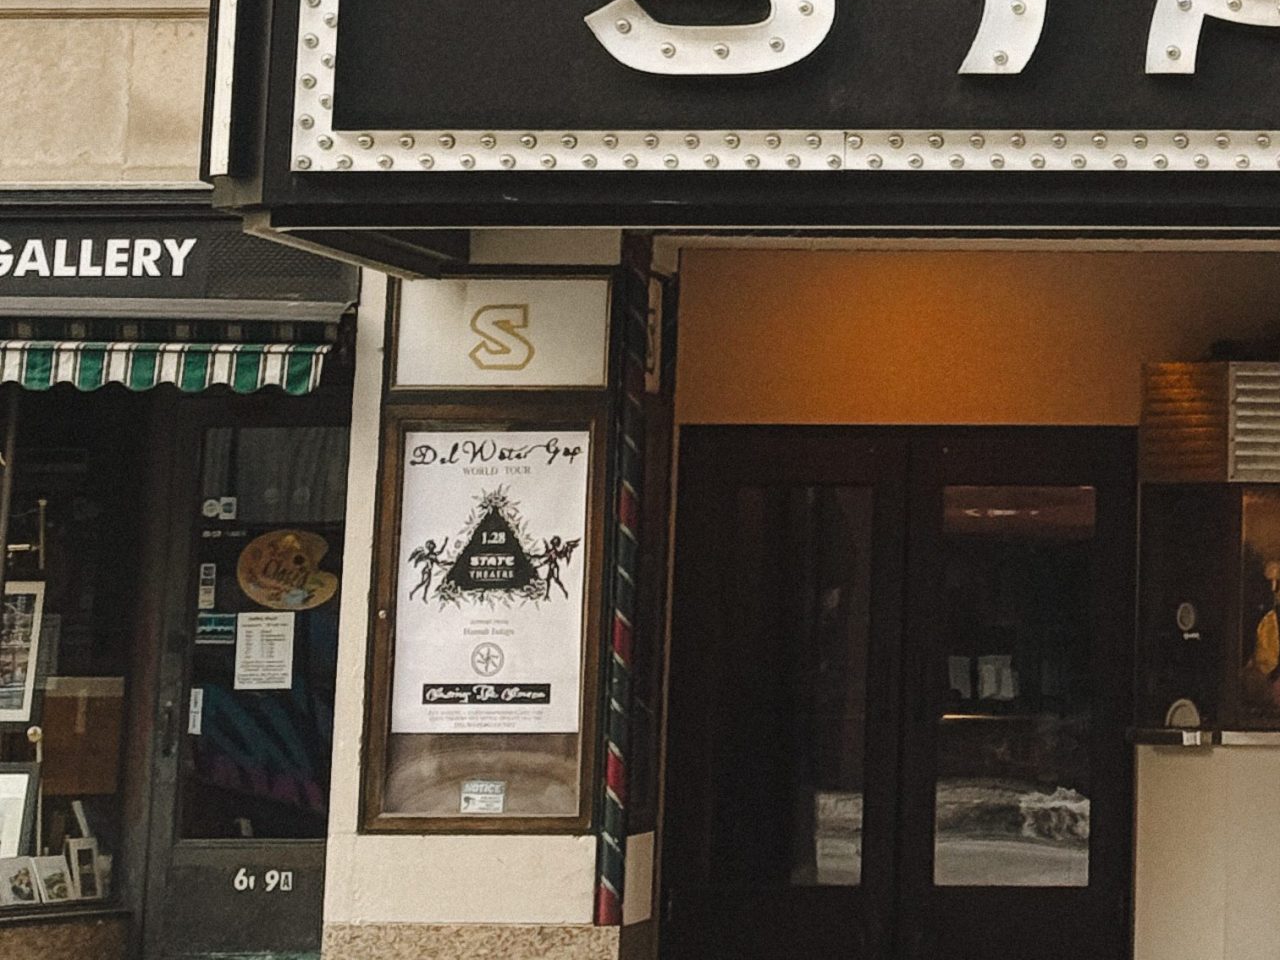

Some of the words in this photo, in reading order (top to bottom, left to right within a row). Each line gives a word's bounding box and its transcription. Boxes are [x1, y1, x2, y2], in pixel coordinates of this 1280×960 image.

[468, 303, 535, 371] S
[463, 466, 499, 476] WORLD
[505, 466, 532, 476] TOUR
[469, 555, 516, 567] STATE
[469, 570, 515, 579] THEATRE
